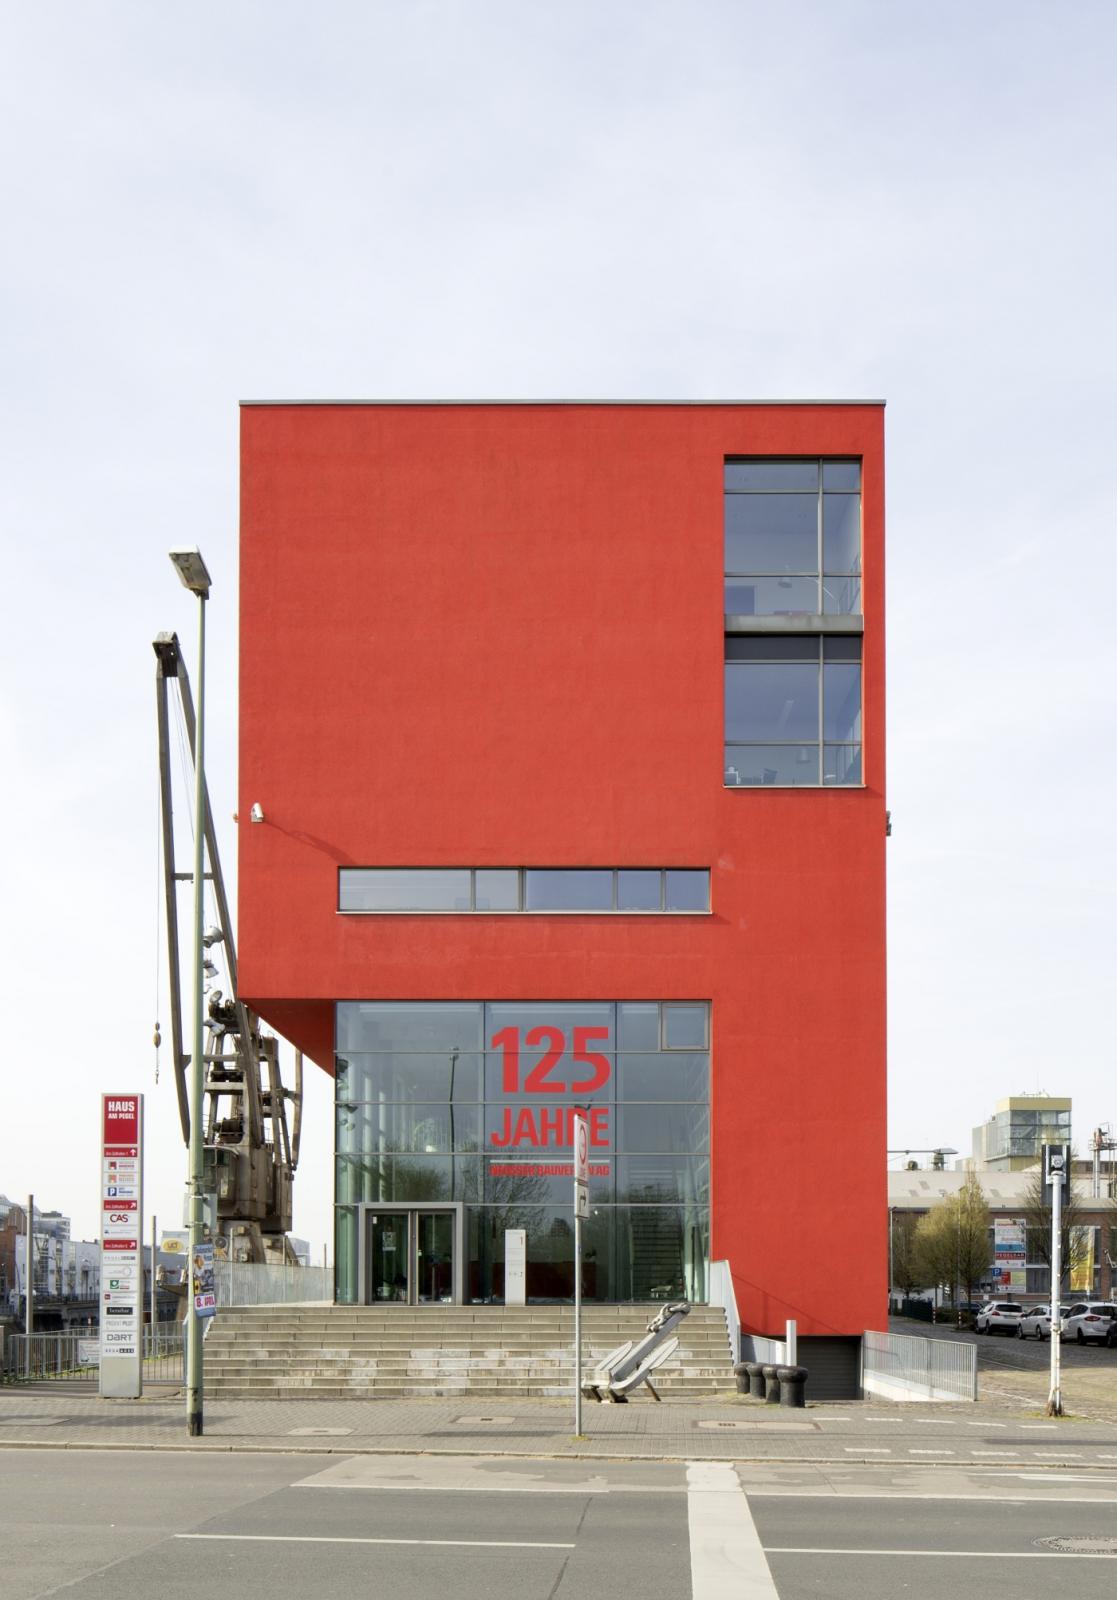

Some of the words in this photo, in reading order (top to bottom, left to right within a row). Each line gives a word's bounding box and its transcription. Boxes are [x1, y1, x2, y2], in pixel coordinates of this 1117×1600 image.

[491, 1025, 611, 1094] 125
[108, 1101, 135, 1112] HAUS
[538, 1165, 593, 1177] BAUVERN
[110, 1214, 128, 1223] CAS
